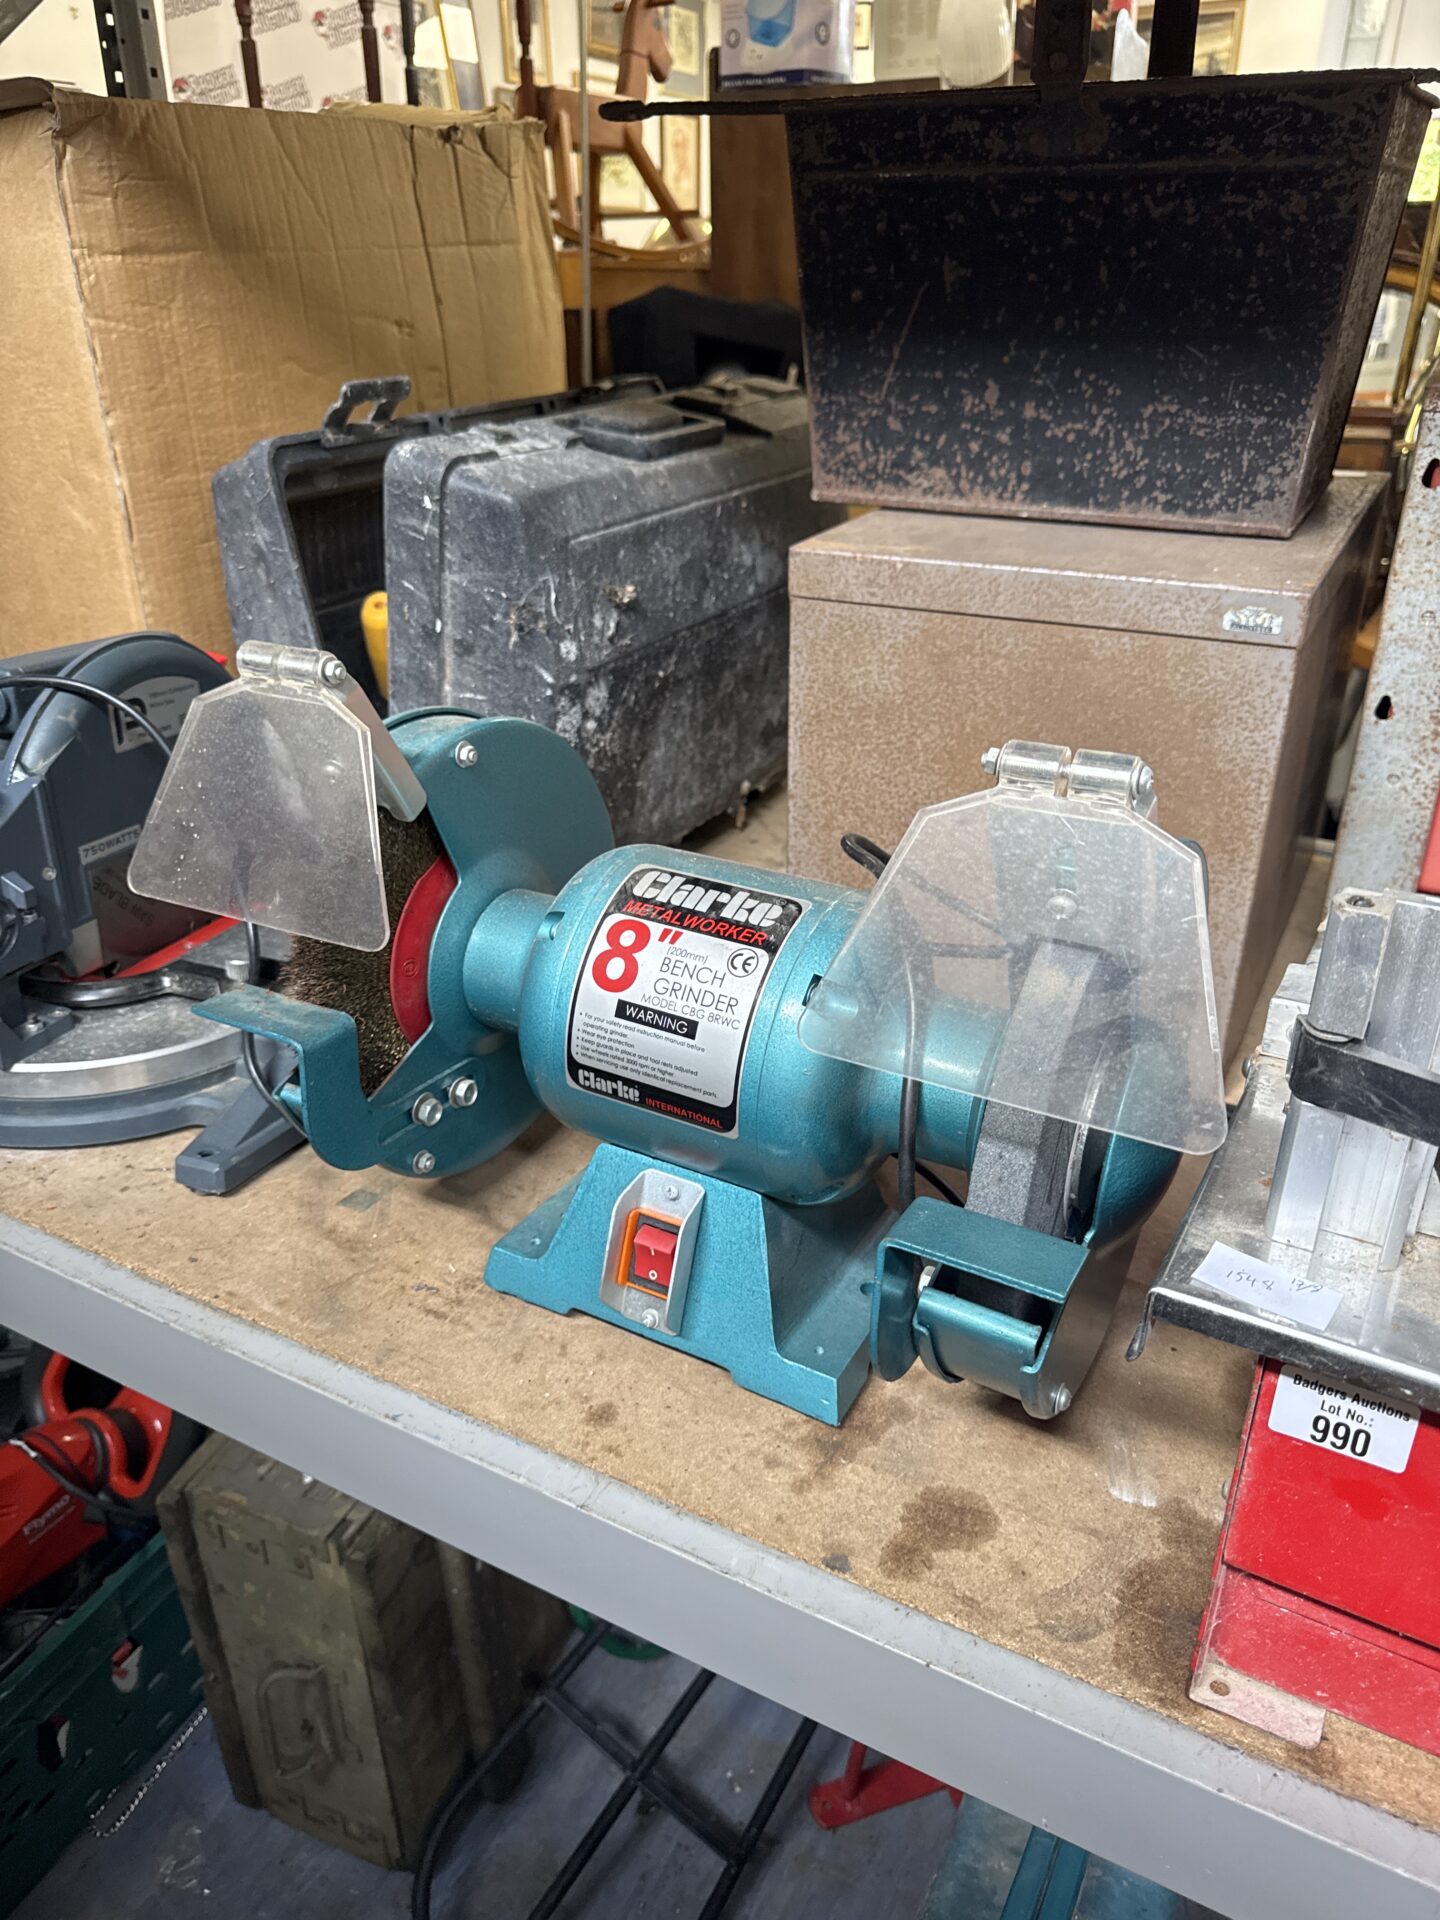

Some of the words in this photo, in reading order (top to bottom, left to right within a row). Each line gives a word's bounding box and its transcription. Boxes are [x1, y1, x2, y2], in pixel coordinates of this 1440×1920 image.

[632, 870, 783, 928] Clarke
[622, 899, 768, 946] METALWORKER
[592, 919, 684, 993] 8"
[659, 956, 726, 988] BENCH
[640, 993, 679, 1013] MODEL
[681, 1004, 706, 1020] CBG
[707, 1011, 741, 1030] 8RWC
[653, 977, 739, 1015] GRINDER
[625, 1004, 689, 1034] WARNING
[687, 1042, 706, 1053] before
[577, 1068, 641, 1102] Clarke
[645, 1097, 723, 1129] INTERNATIONAL
[1293, 1374, 1348, 1400] Badgers
[1350, 1393, 1411, 1422] Auctions
[1320, 1399, 1341, 1417] Lot
[1345, 1408, 1375, 1428] No.:
[1310, 1415, 1372, 1457] 990
